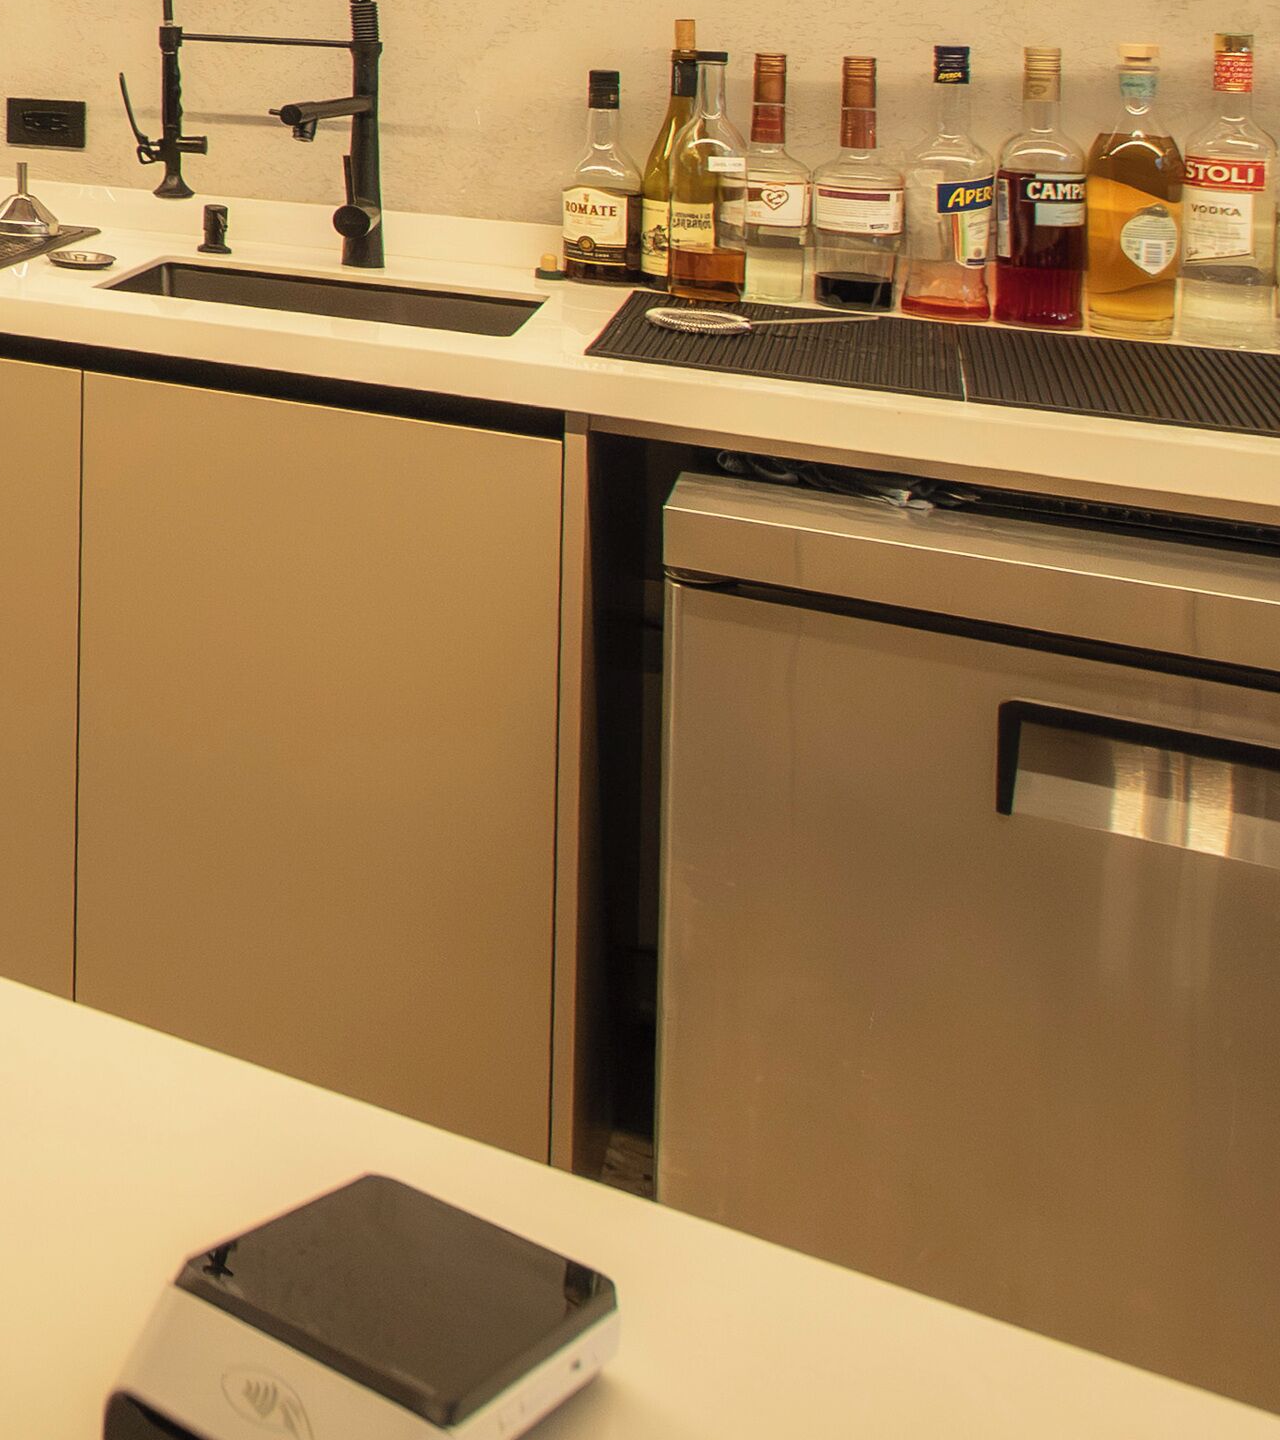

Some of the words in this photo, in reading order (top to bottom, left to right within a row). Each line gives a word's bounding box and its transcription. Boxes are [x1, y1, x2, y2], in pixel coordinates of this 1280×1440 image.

[1185, 161, 1255, 185] STOLI
[947, 186, 993, 208] APER
[1026, 181, 1081, 200] CAMP
[565, 200, 617, 217] ROMATE
[1191, 203, 1242, 217] VODKA
